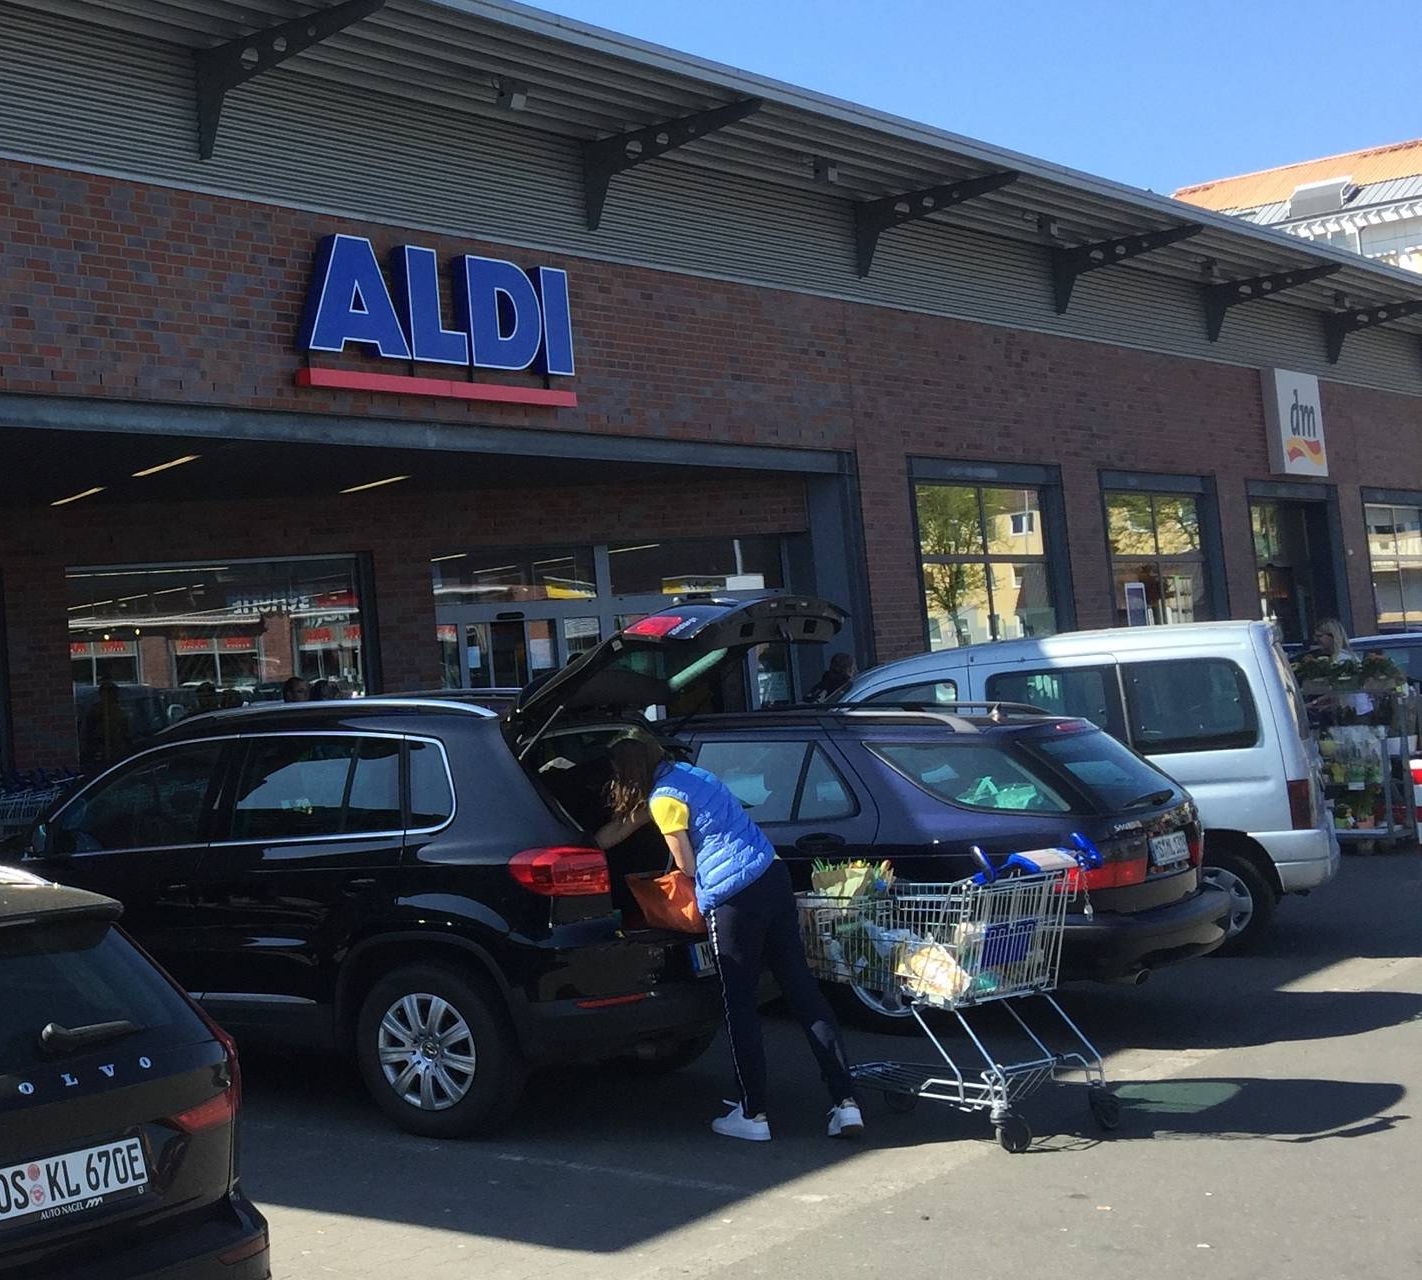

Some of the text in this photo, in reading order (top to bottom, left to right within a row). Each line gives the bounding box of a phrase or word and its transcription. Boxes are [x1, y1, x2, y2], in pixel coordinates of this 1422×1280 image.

[304, 233, 575, 377] ALDI
[1290, 389, 1316, 438] dm
[45, 1159, 81, 1201] KL
[85, 1143, 145, 1191] 670E
[40, 1201, 84, 1220] AUTO NAGEL
